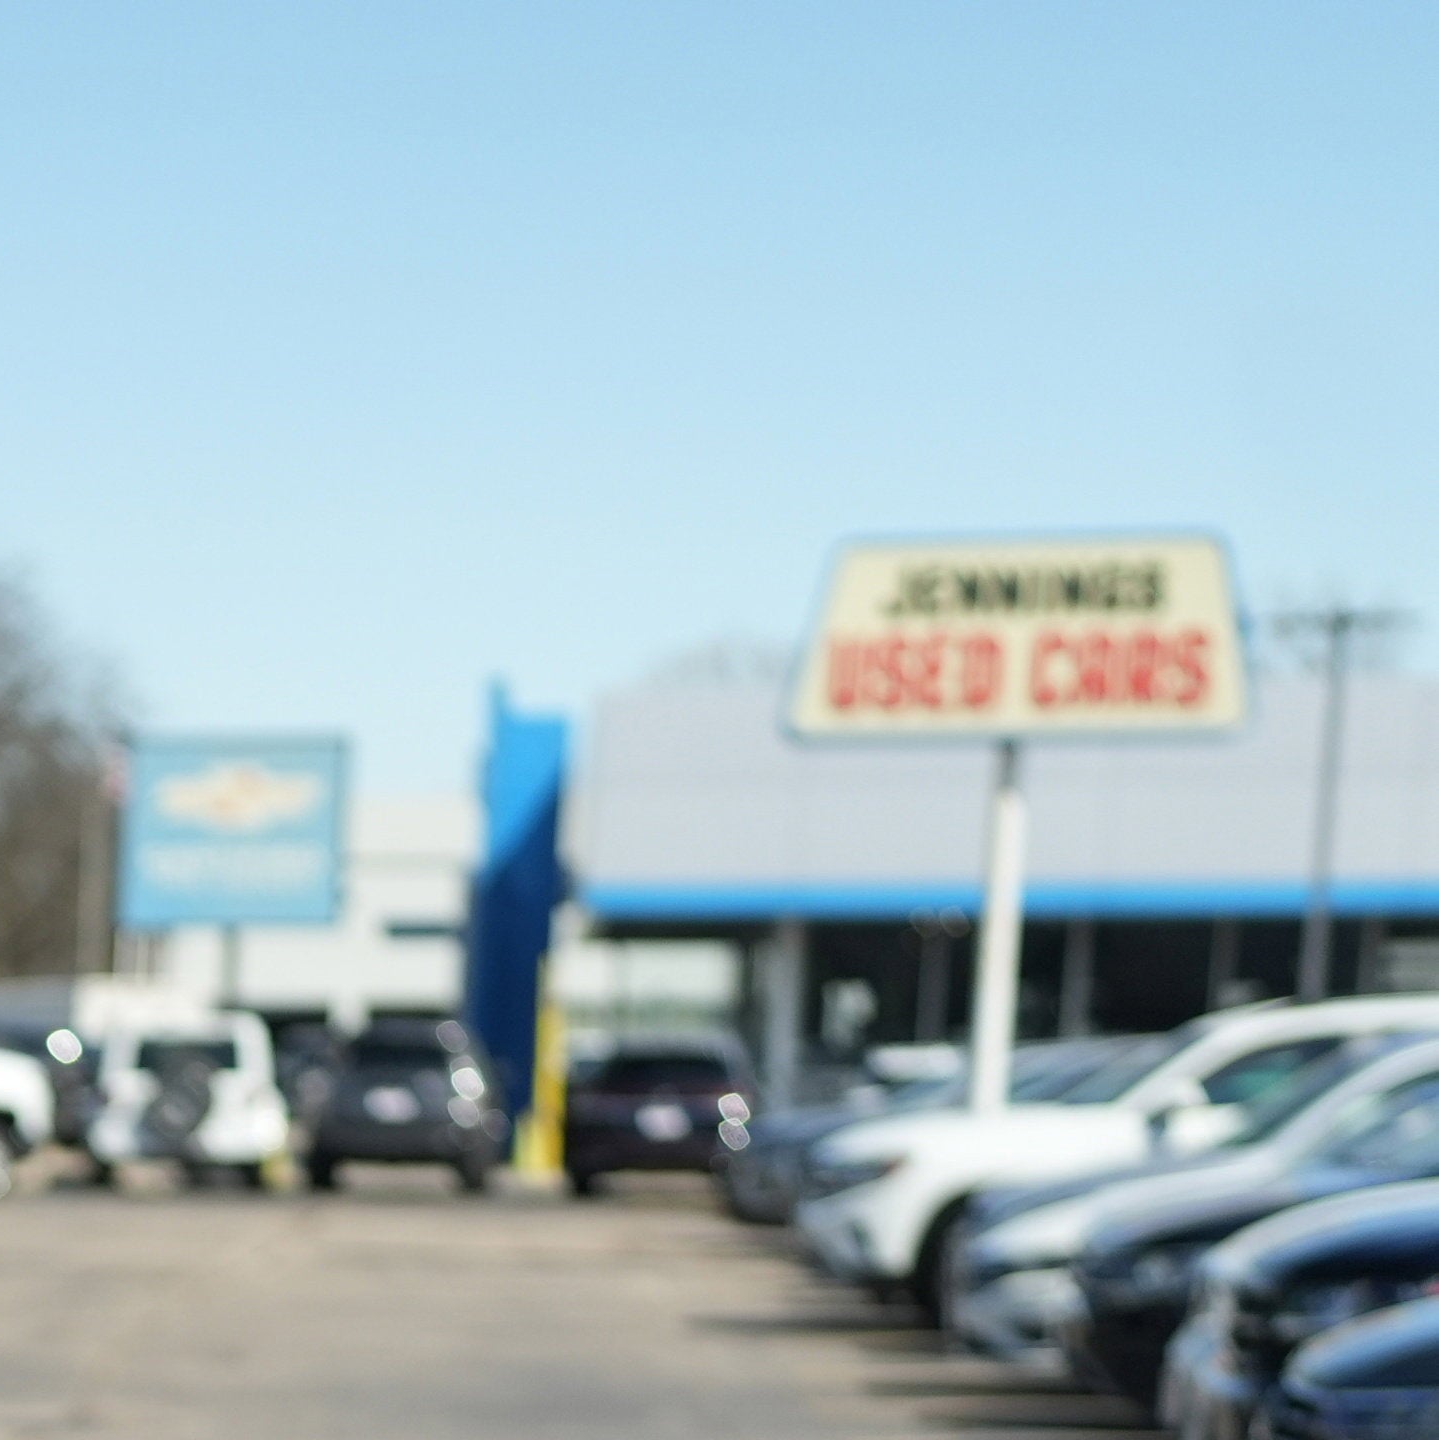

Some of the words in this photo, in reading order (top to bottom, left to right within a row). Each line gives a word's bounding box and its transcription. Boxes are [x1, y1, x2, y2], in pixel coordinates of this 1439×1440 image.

[880, 560, 1168, 615] JENNINGS
[826, 629, 1003, 711] USED
[1031, 627, 1213, 710] CARS
